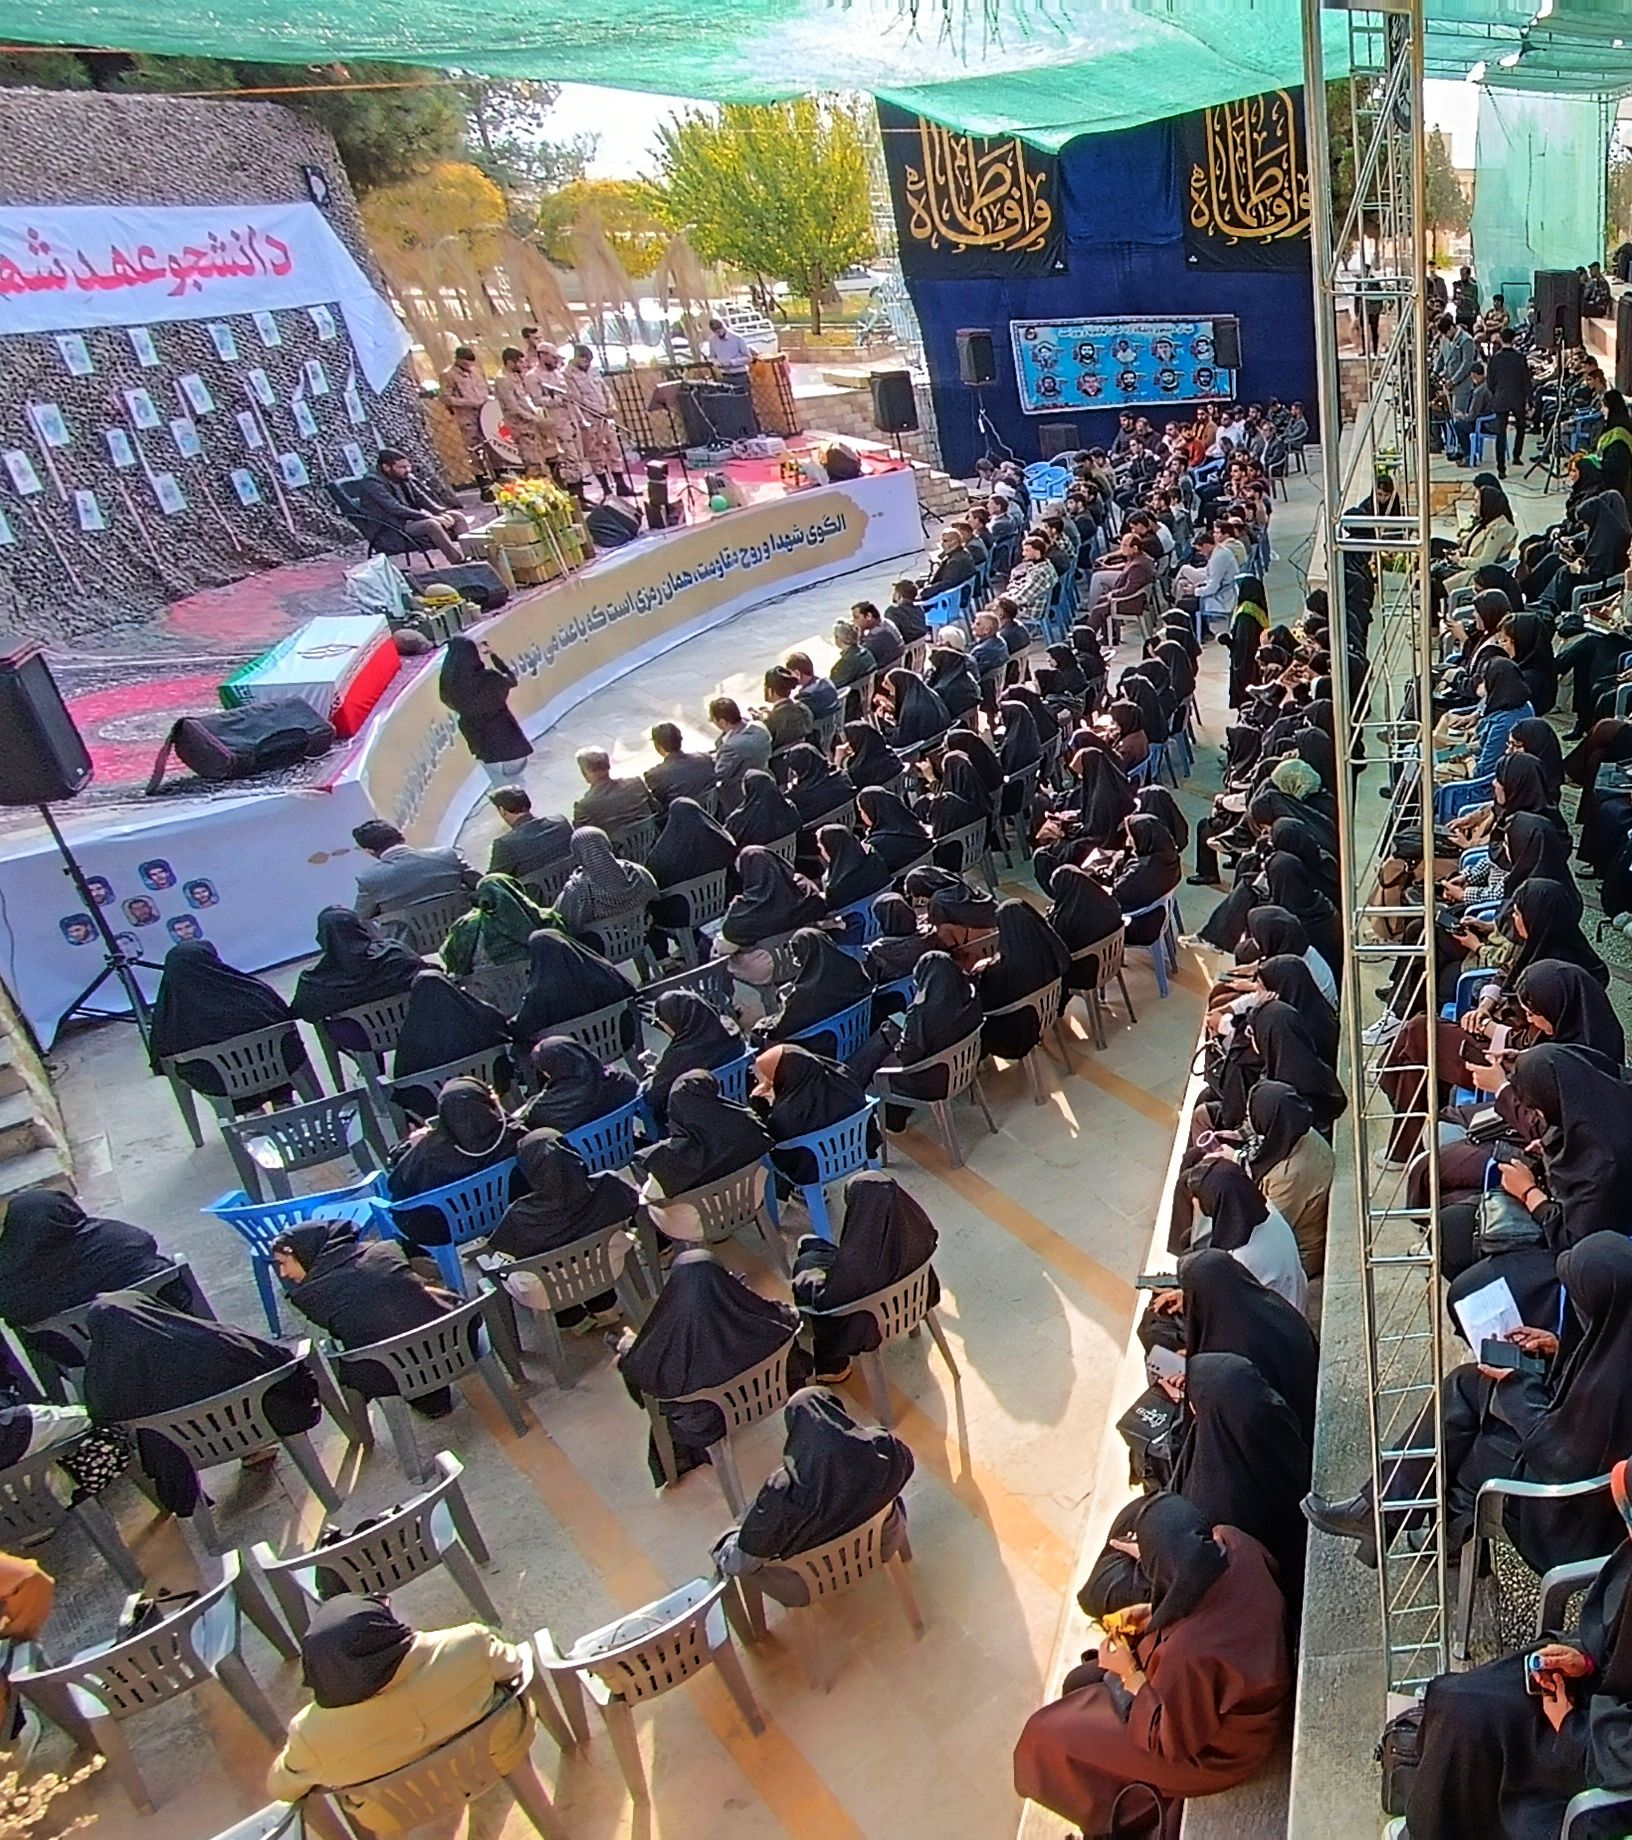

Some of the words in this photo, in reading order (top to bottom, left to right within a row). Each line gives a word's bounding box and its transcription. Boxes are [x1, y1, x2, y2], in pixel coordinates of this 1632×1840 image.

[72, 244, 166, 291] عهد
[168, 225, 292, 297] دانشجو
[770, 524, 804, 552] شهدا
[806, 513, 847, 546] الگوی
[740, 546, 763, 569] روح
[763, 541, 771, 560] و
[635, 585, 663, 615] رمزی
[662, 572, 693, 601] همان
[587, 605, 607, 632] که
[607, 592, 634, 622] است
